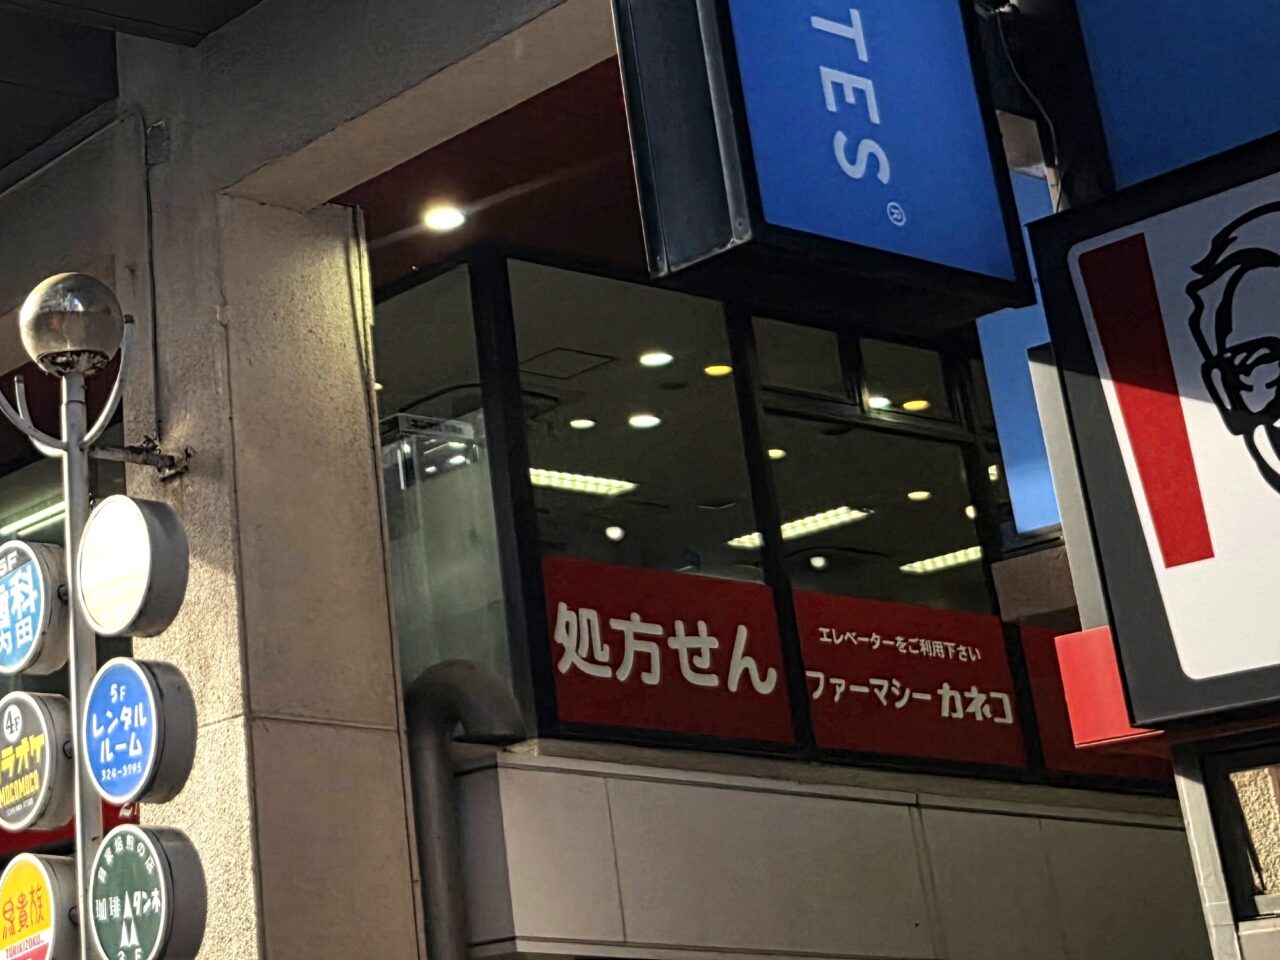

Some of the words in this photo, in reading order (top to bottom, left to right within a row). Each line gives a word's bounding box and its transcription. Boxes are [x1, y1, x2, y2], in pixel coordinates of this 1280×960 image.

[554, 601, 778, 696] 処方せん
[817, 626, 982, 663] エレベーターをご利用下さい
[110, 683, 126, 703] 5F
[5, 709, 20, 735] 4F
[92, 701, 148, 738] レンタル
[100, 732, 142, 763] ルーム
